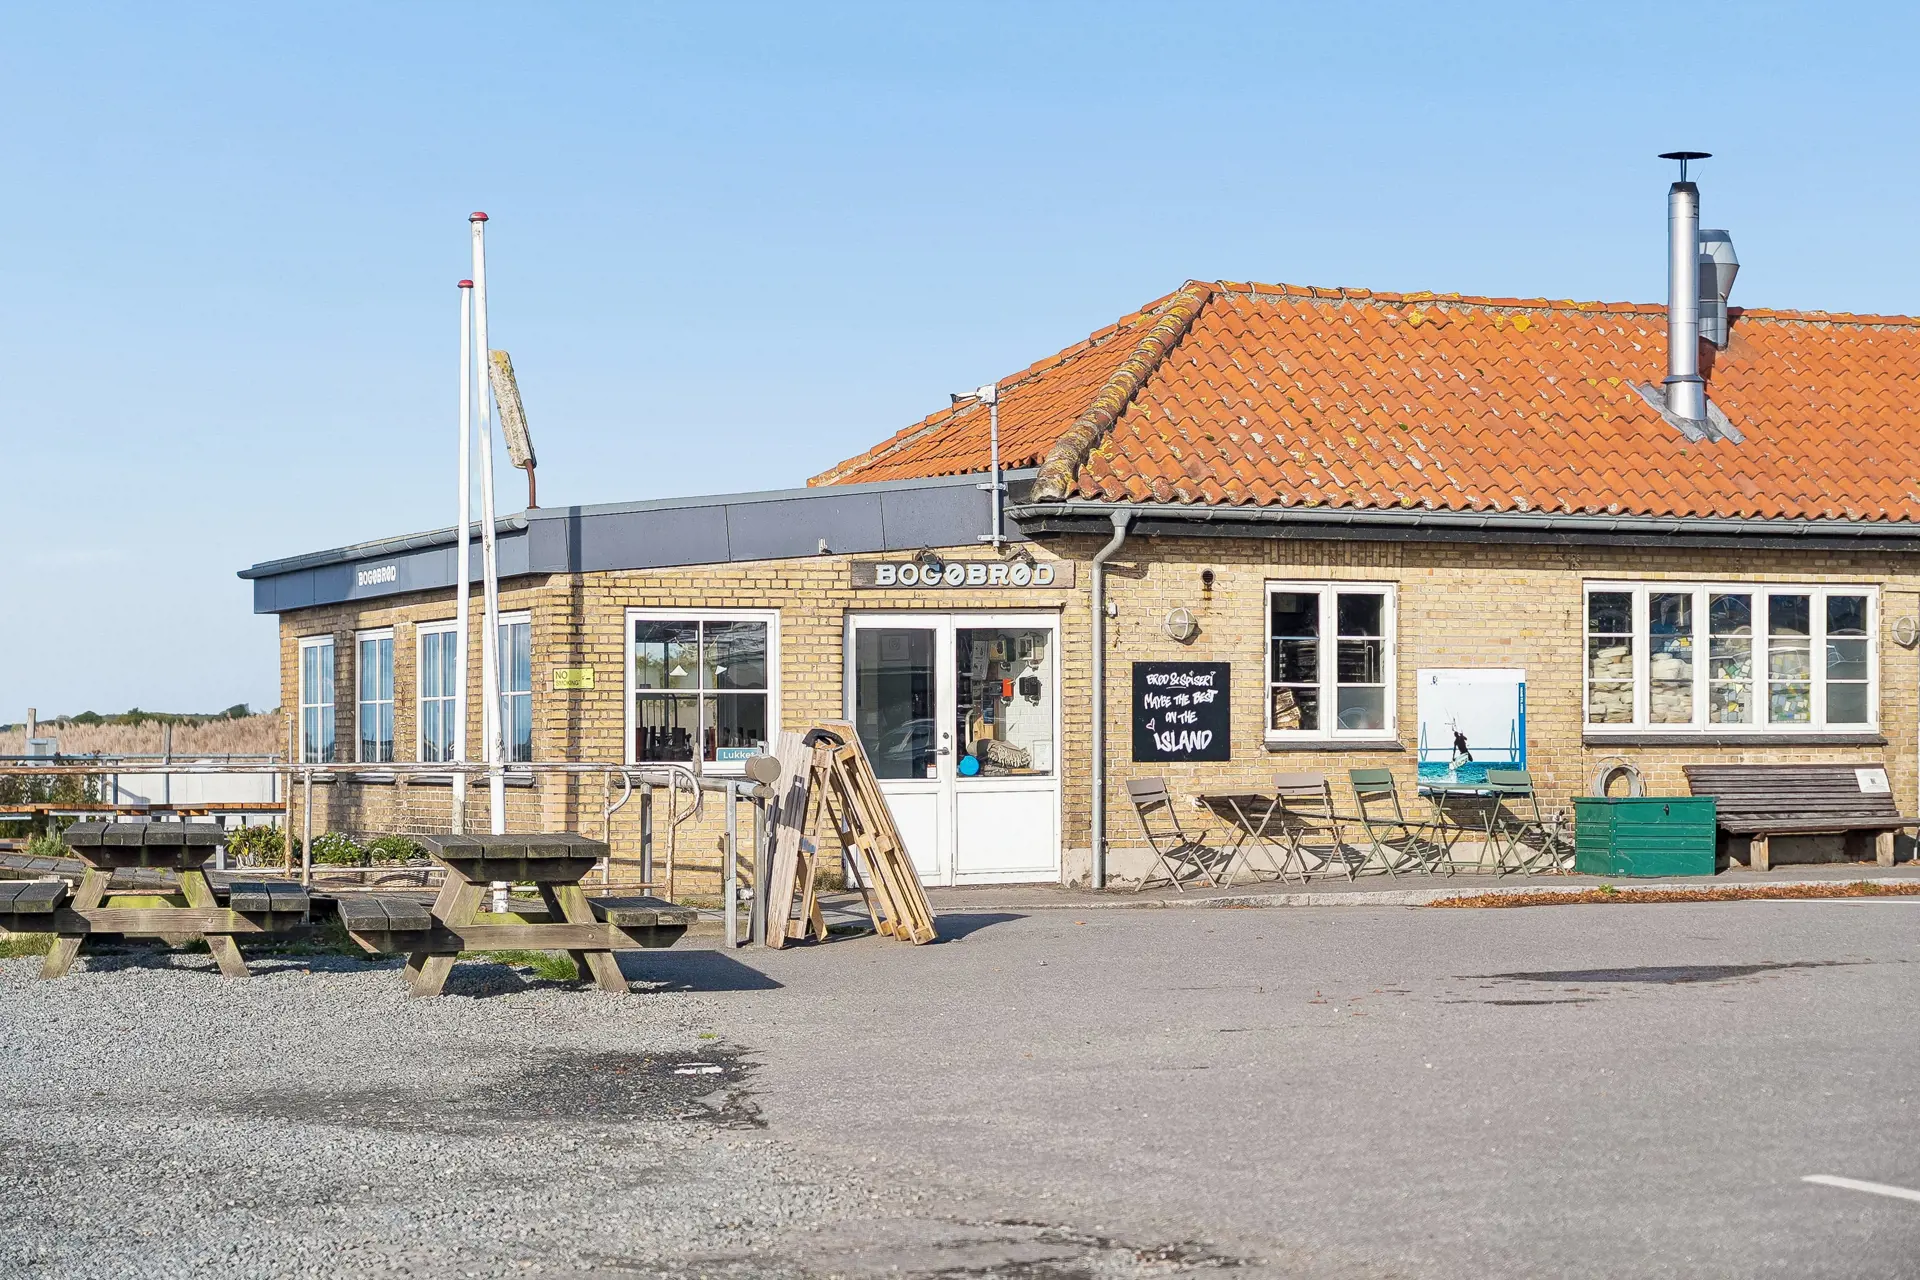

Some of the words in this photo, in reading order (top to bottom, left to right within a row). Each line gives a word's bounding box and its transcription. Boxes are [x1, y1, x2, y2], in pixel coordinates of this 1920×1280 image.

[875, 563, 1055, 586] BOGØBRØD
[555, 671, 568, 680] NO
[1173, 693, 1191, 706] THE
[1192, 689, 1219, 705] BEST
[1178, 710, 1198, 724] THE
[1153, 730, 1213, 753] ISLAND
[723, 751, 755, 759] Lukket
